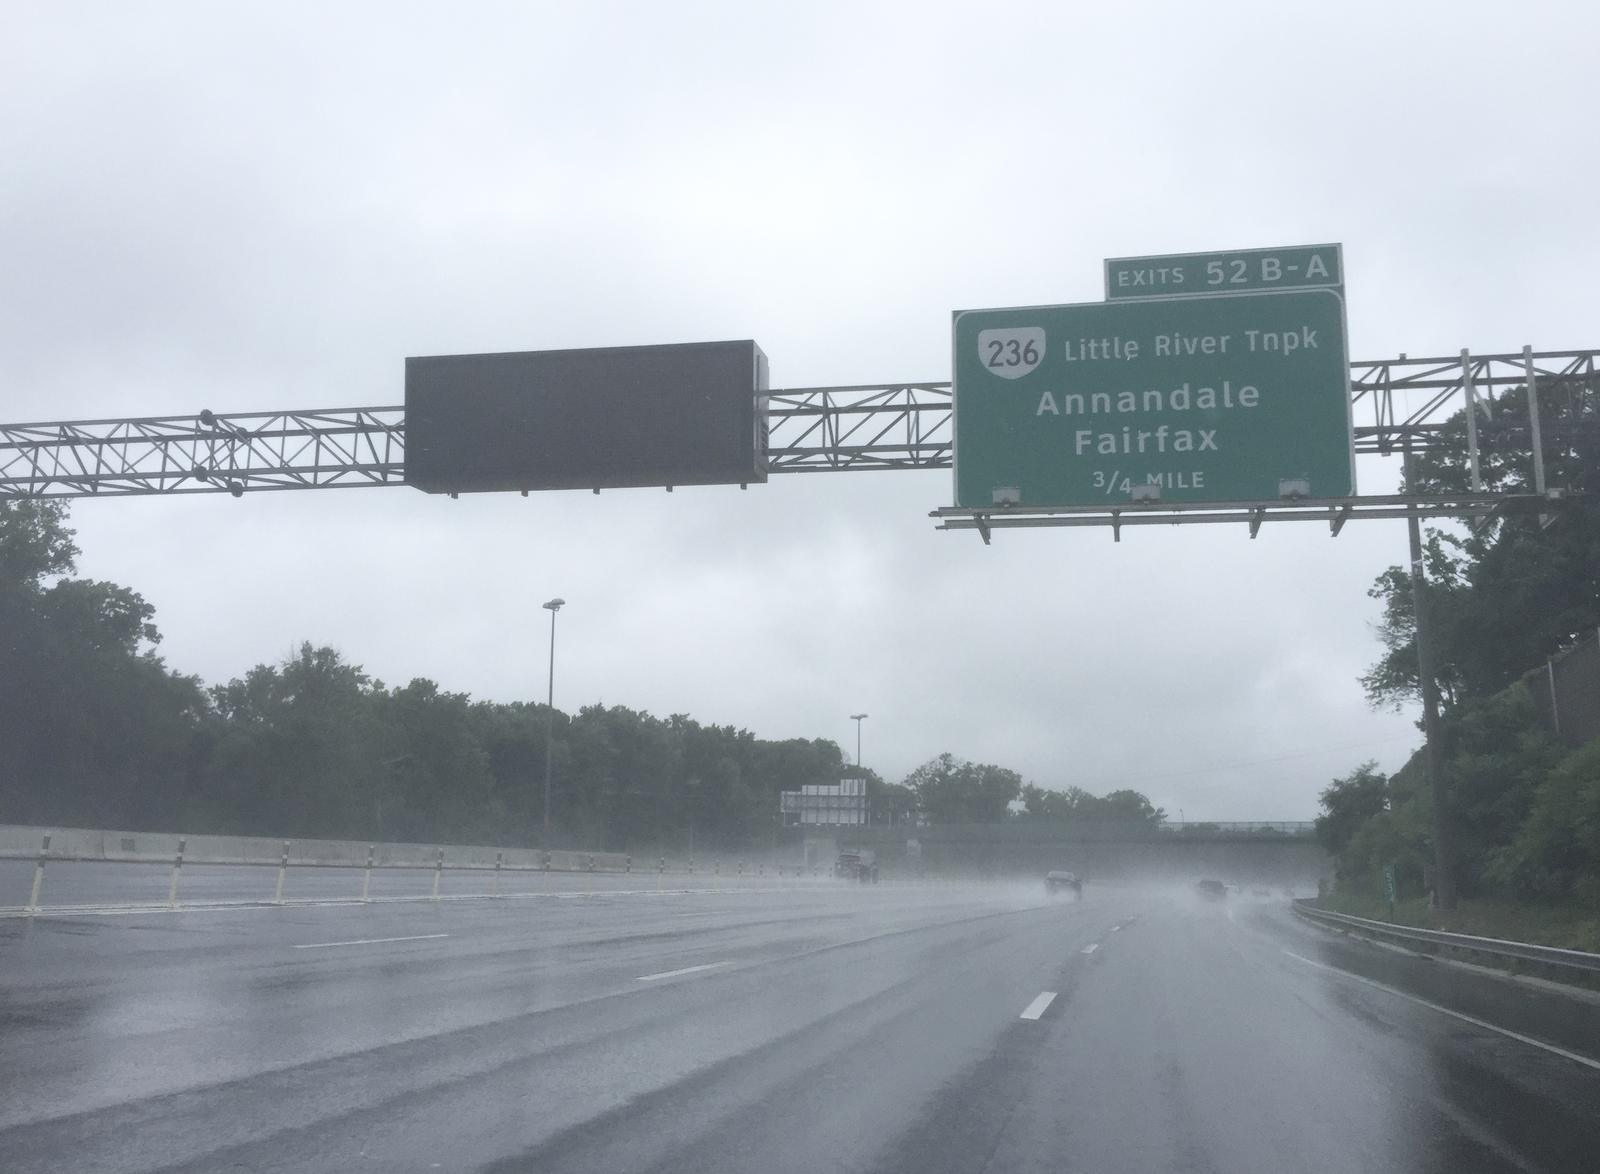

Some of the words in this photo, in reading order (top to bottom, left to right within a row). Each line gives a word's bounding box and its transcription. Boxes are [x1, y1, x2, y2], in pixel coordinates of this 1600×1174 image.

[1118, 268, 1184, 287] EXITS
[1207, 260, 1248, 285] 52
[1261, 254, 1329, 281] B-A
[987, 338, 1039, 367] 236
[1065, 337, 1139, 361] Little
[1155, 332, 1230, 357] River
[1246, 325, 1319, 355] Tnpk
[1036, 381, 1259, 416] Annandale
[1075, 425, 1218, 456] Fairfax
[1093, 470, 1131, 494] 3/4
[1147, 471, 1204, 489] MILE
